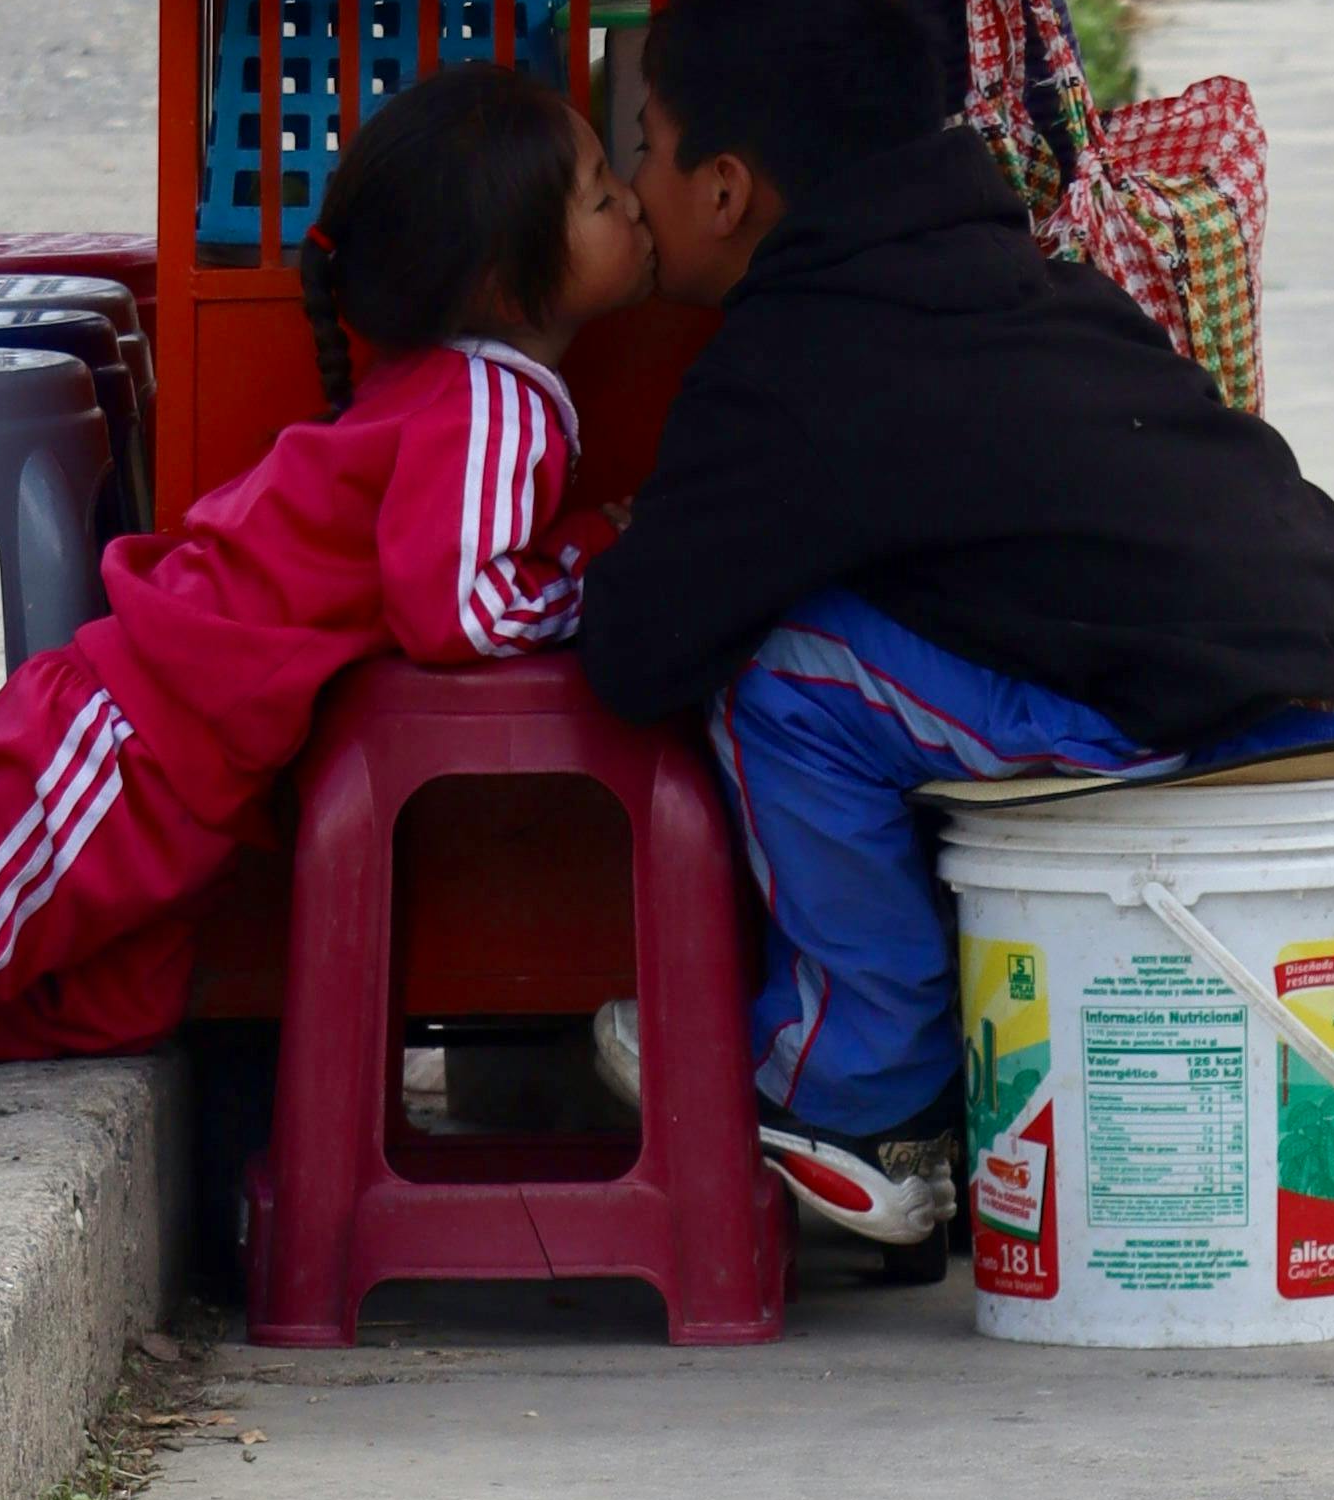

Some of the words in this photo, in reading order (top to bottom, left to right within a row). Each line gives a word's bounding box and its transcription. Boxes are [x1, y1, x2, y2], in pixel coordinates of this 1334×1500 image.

[1086, 1010, 1164, 1024] Información
[1169, 1009, 1244, 1024] Nutricional
[1088, 1055, 1120, 1066] Valor
[1216, 1055, 1243, 1066] kcal
[1088, 1068, 1158, 1081] energético
[1000, 1243, 1030, 1277] 18
[1034, 1247, 1048, 1277] L
